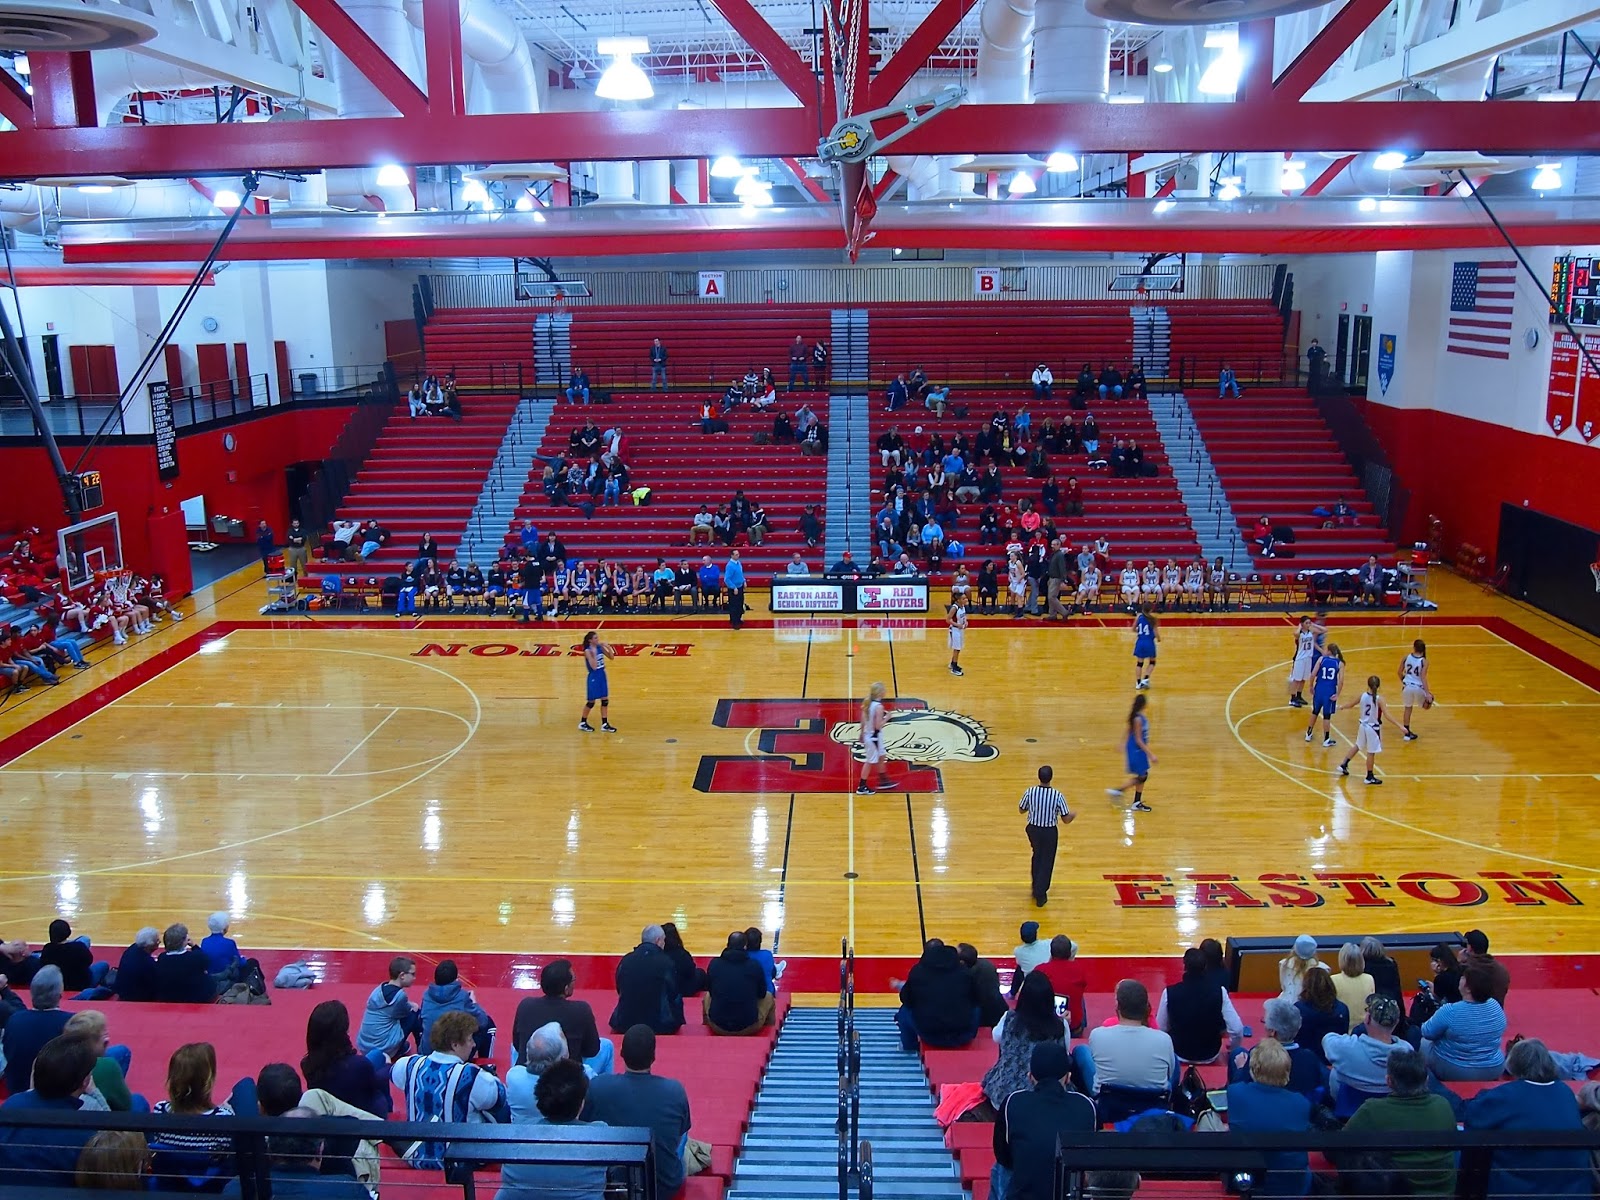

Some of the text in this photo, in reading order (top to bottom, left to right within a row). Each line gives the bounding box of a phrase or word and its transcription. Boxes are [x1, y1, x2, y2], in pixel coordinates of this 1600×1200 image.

[705, 279, 719, 295] A
[981, 275, 994, 291] B
[777, 591, 839, 600] EASTON AREA
[893, 587, 914, 597] RED
[777, 600, 839, 608] SCHOOL DISTRICT
[882, 598, 924, 608] ROVERS
[1138, 623, 1150, 635] 14
[1303, 642, 1312, 650] 13
[1321, 666, 1336, 680] 13
[1406, 664, 1420, 677] 24
[1364, 704, 1371, 716] 2
[1103, 872, 1584, 908] EASTON
